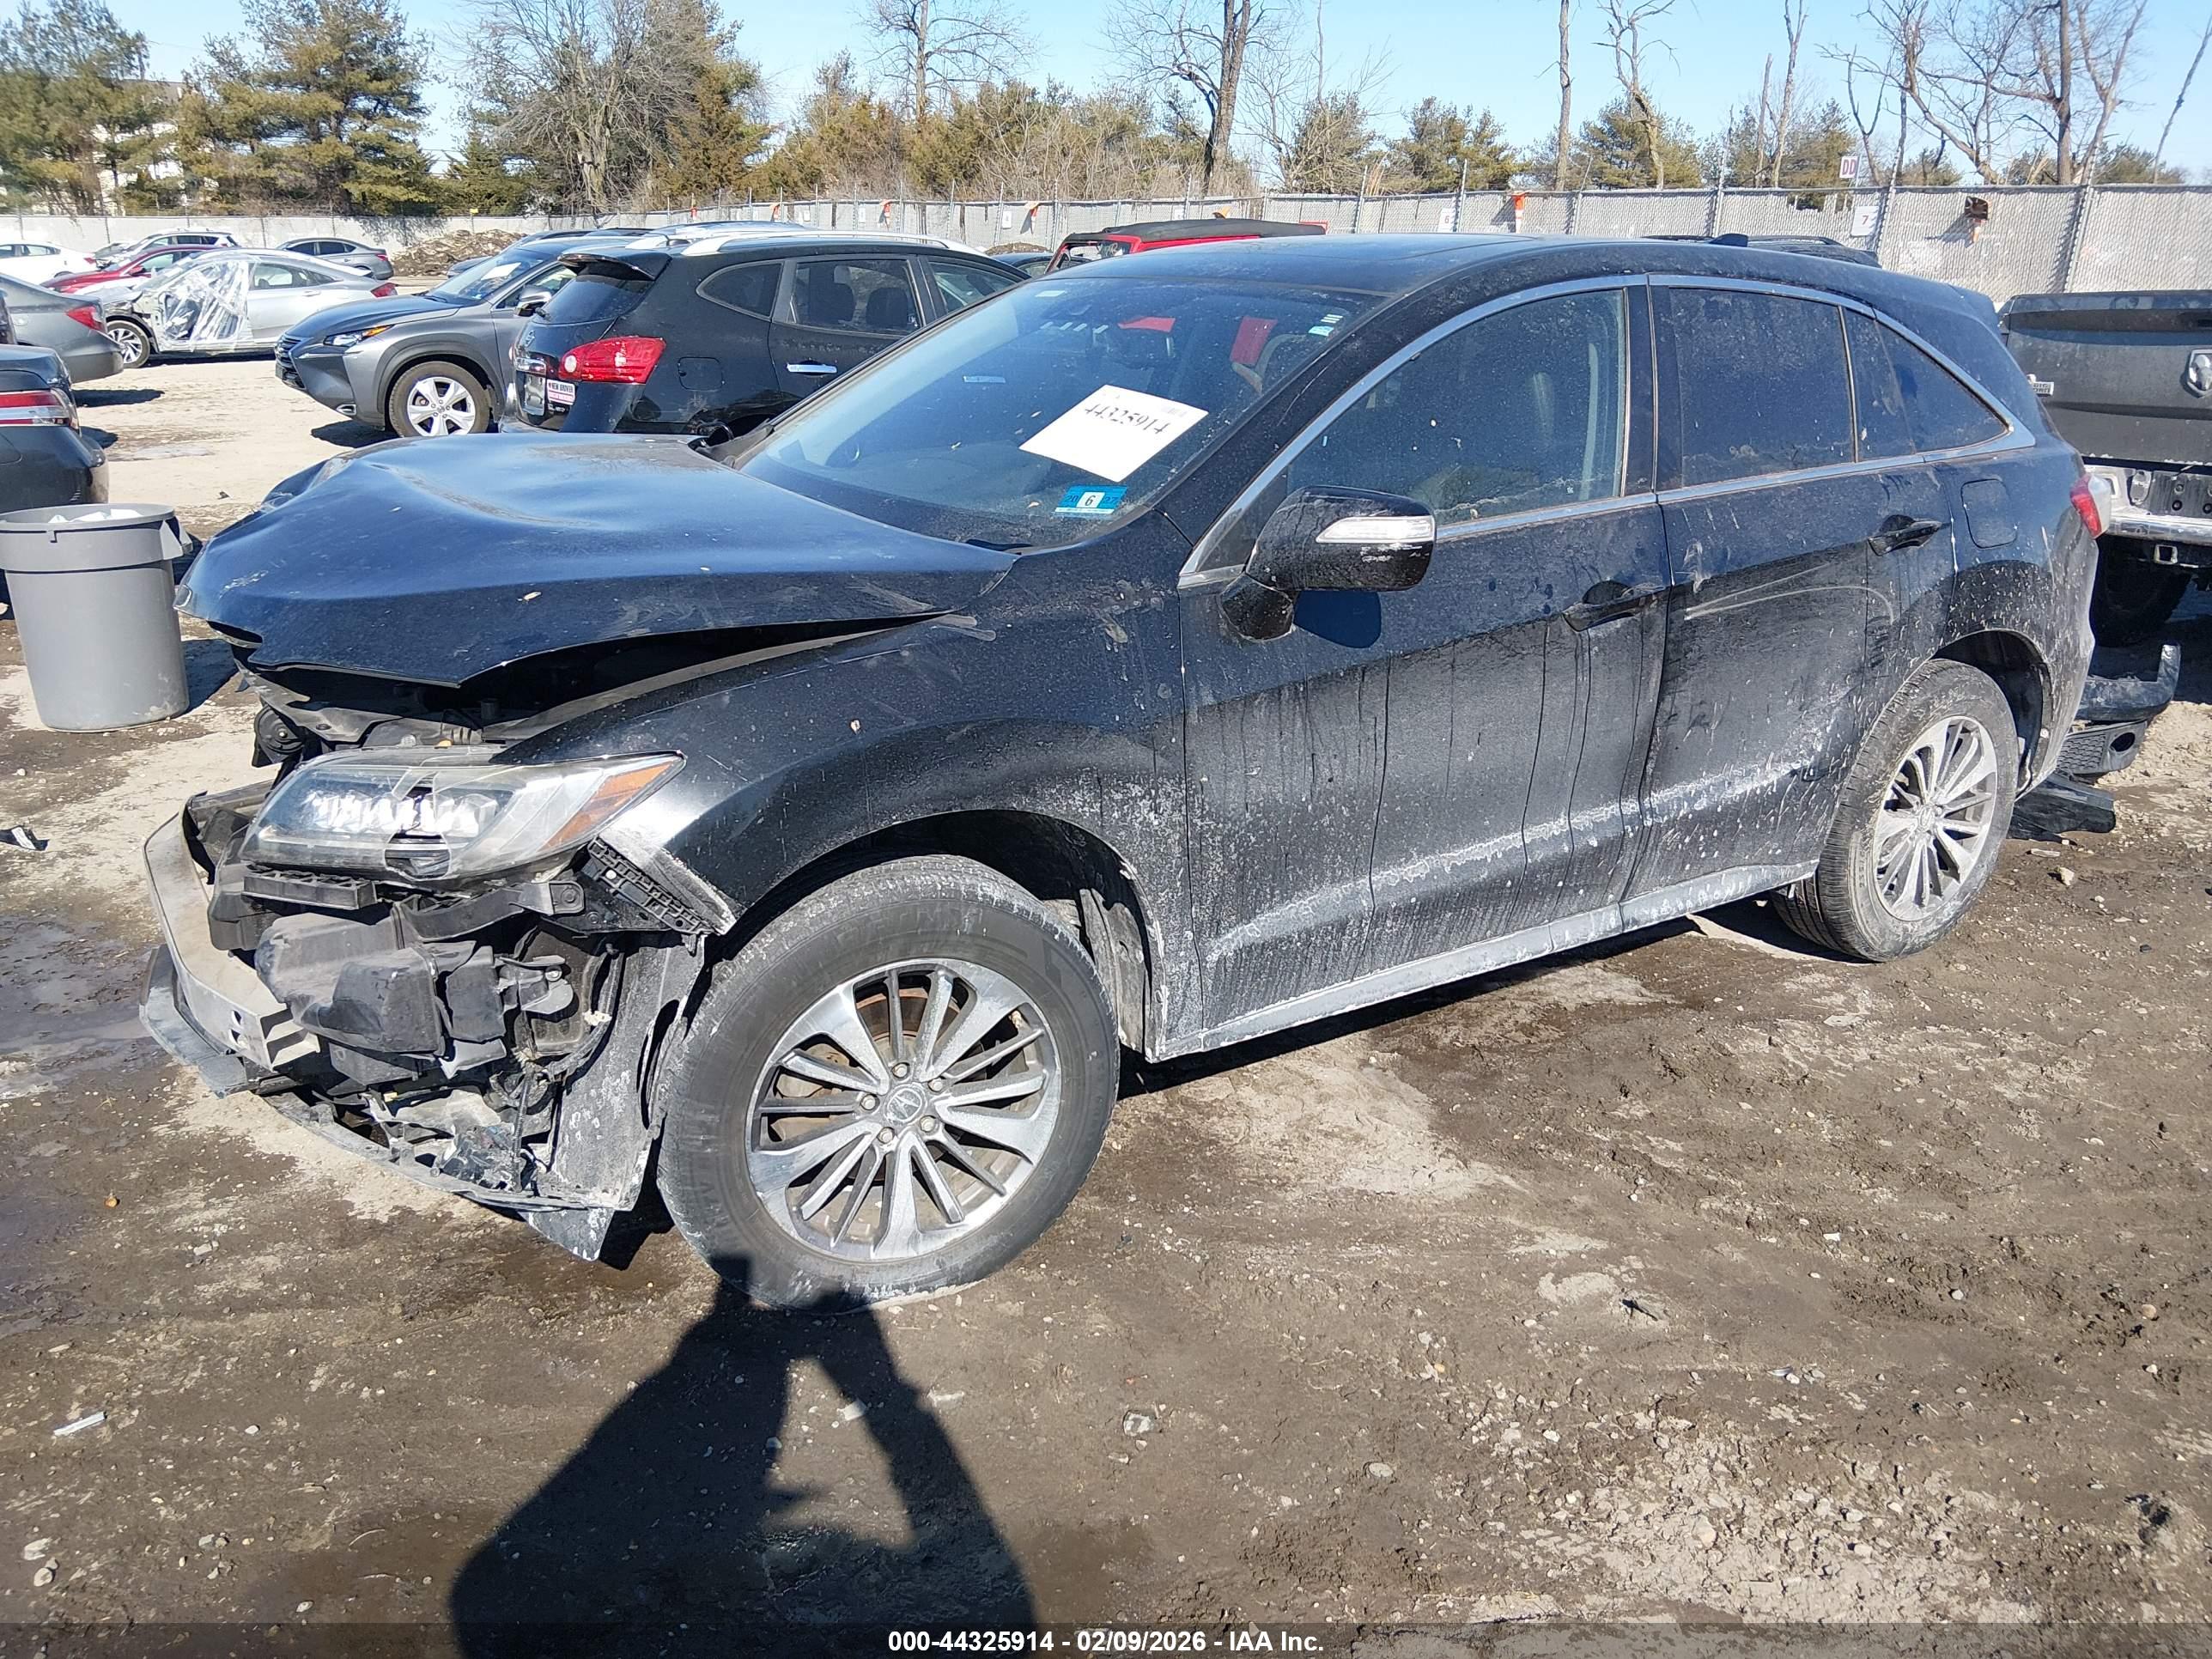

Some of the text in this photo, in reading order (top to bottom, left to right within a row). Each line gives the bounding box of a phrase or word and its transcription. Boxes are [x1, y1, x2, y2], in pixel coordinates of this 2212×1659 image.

[1842, 159, 1856, 175] DD
[1862, 215, 1869, 225] 7
[1085, 495, 1096, 506] 6
